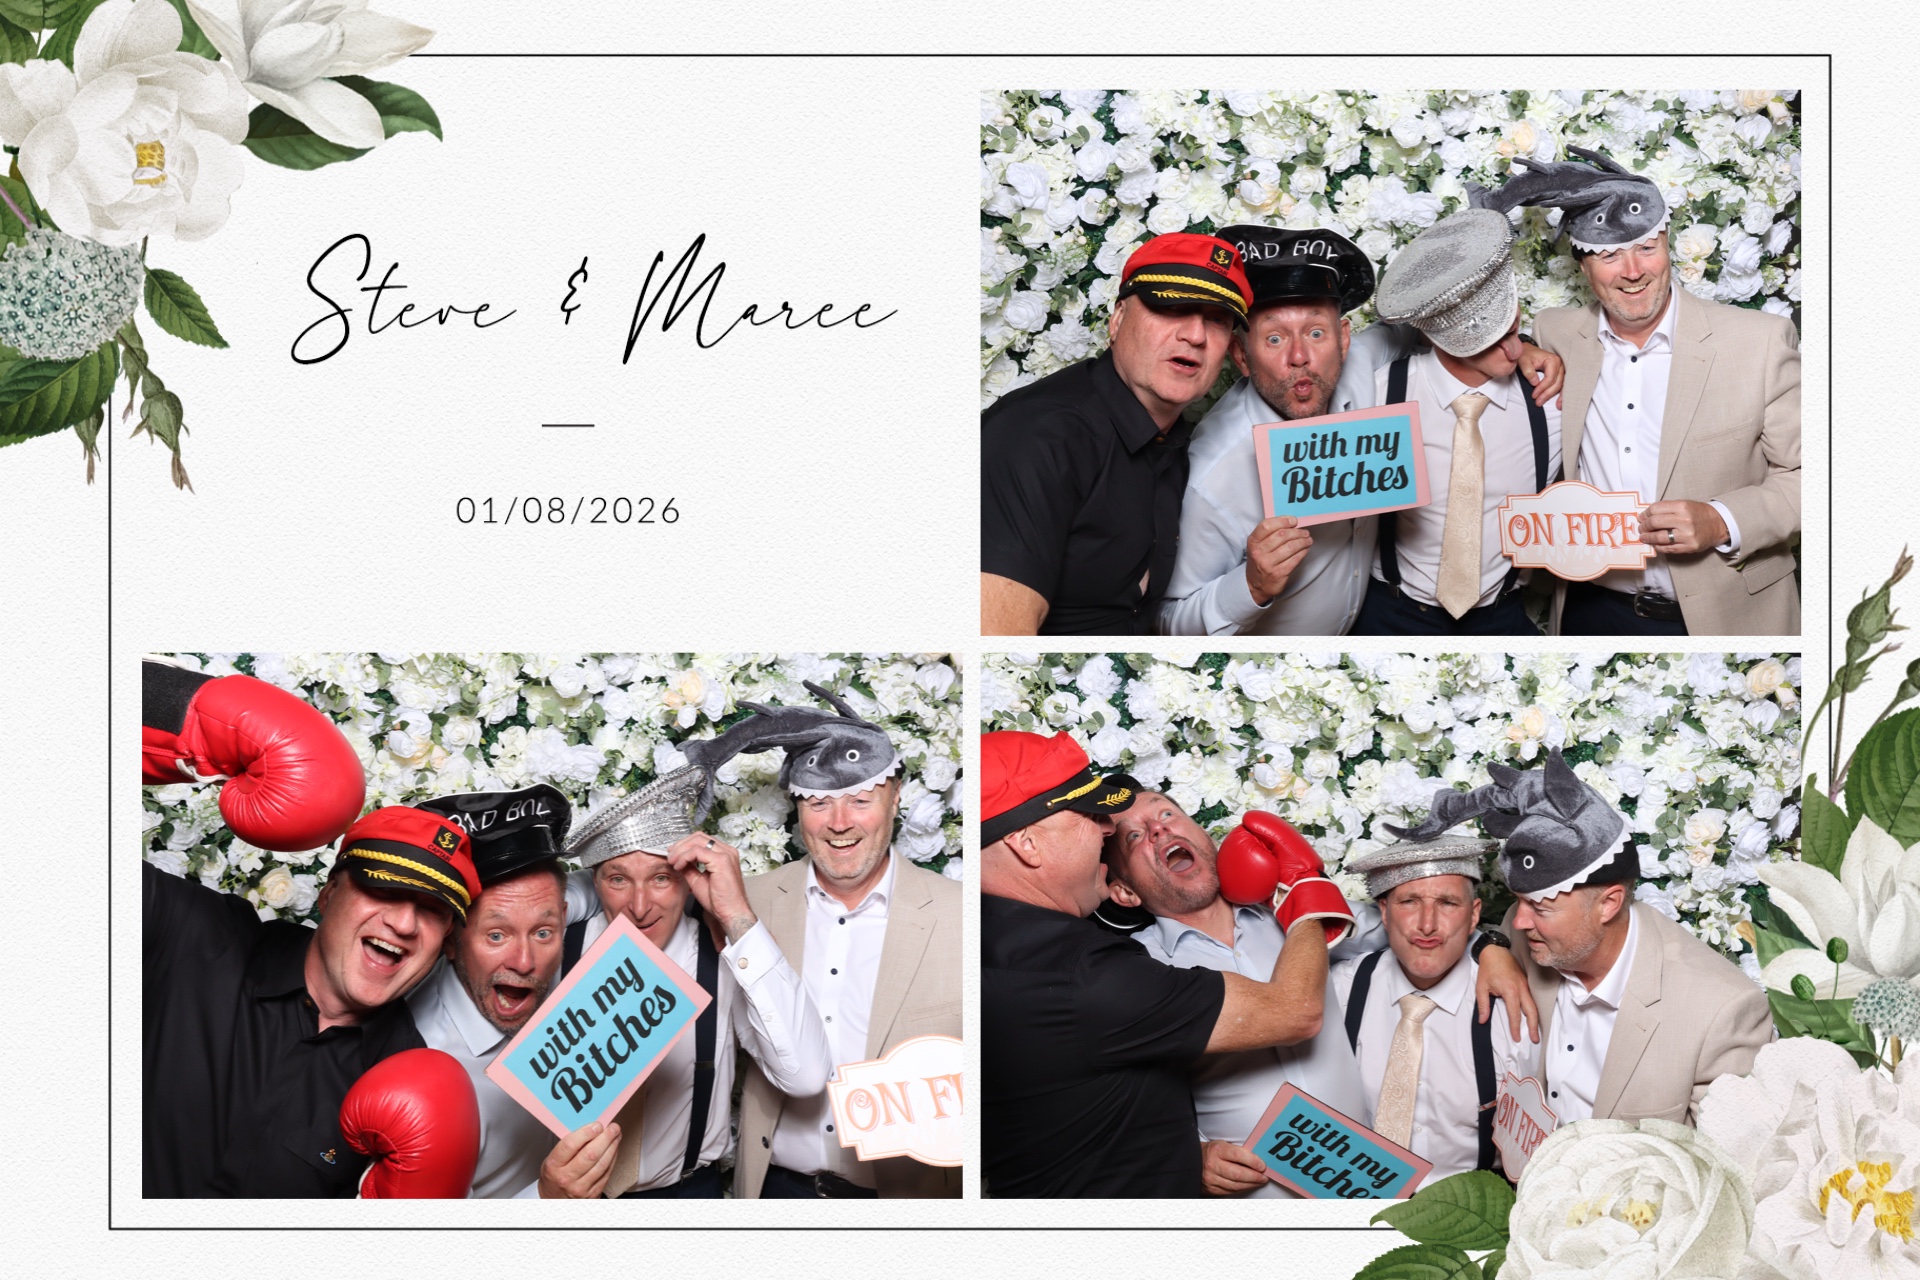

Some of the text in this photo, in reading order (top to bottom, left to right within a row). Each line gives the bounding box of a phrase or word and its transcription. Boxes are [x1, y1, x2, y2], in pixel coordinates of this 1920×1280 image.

[1235, 241, 1280, 262] BAD
[1283, 430, 1401, 464] with my
[1281, 464, 1410, 504] Bitches
[1508, 511, 1642, 549] ON FIRE
[528, 956, 646, 1080] with my
[550, 984, 678, 1114] Bitches
[845, 1081, 915, 1132] ON
[1497, 1092, 1520, 1136] ON
[1267, 1131, 1382, 1199] Bitche
[1288, 1113, 1399, 1190] with my
